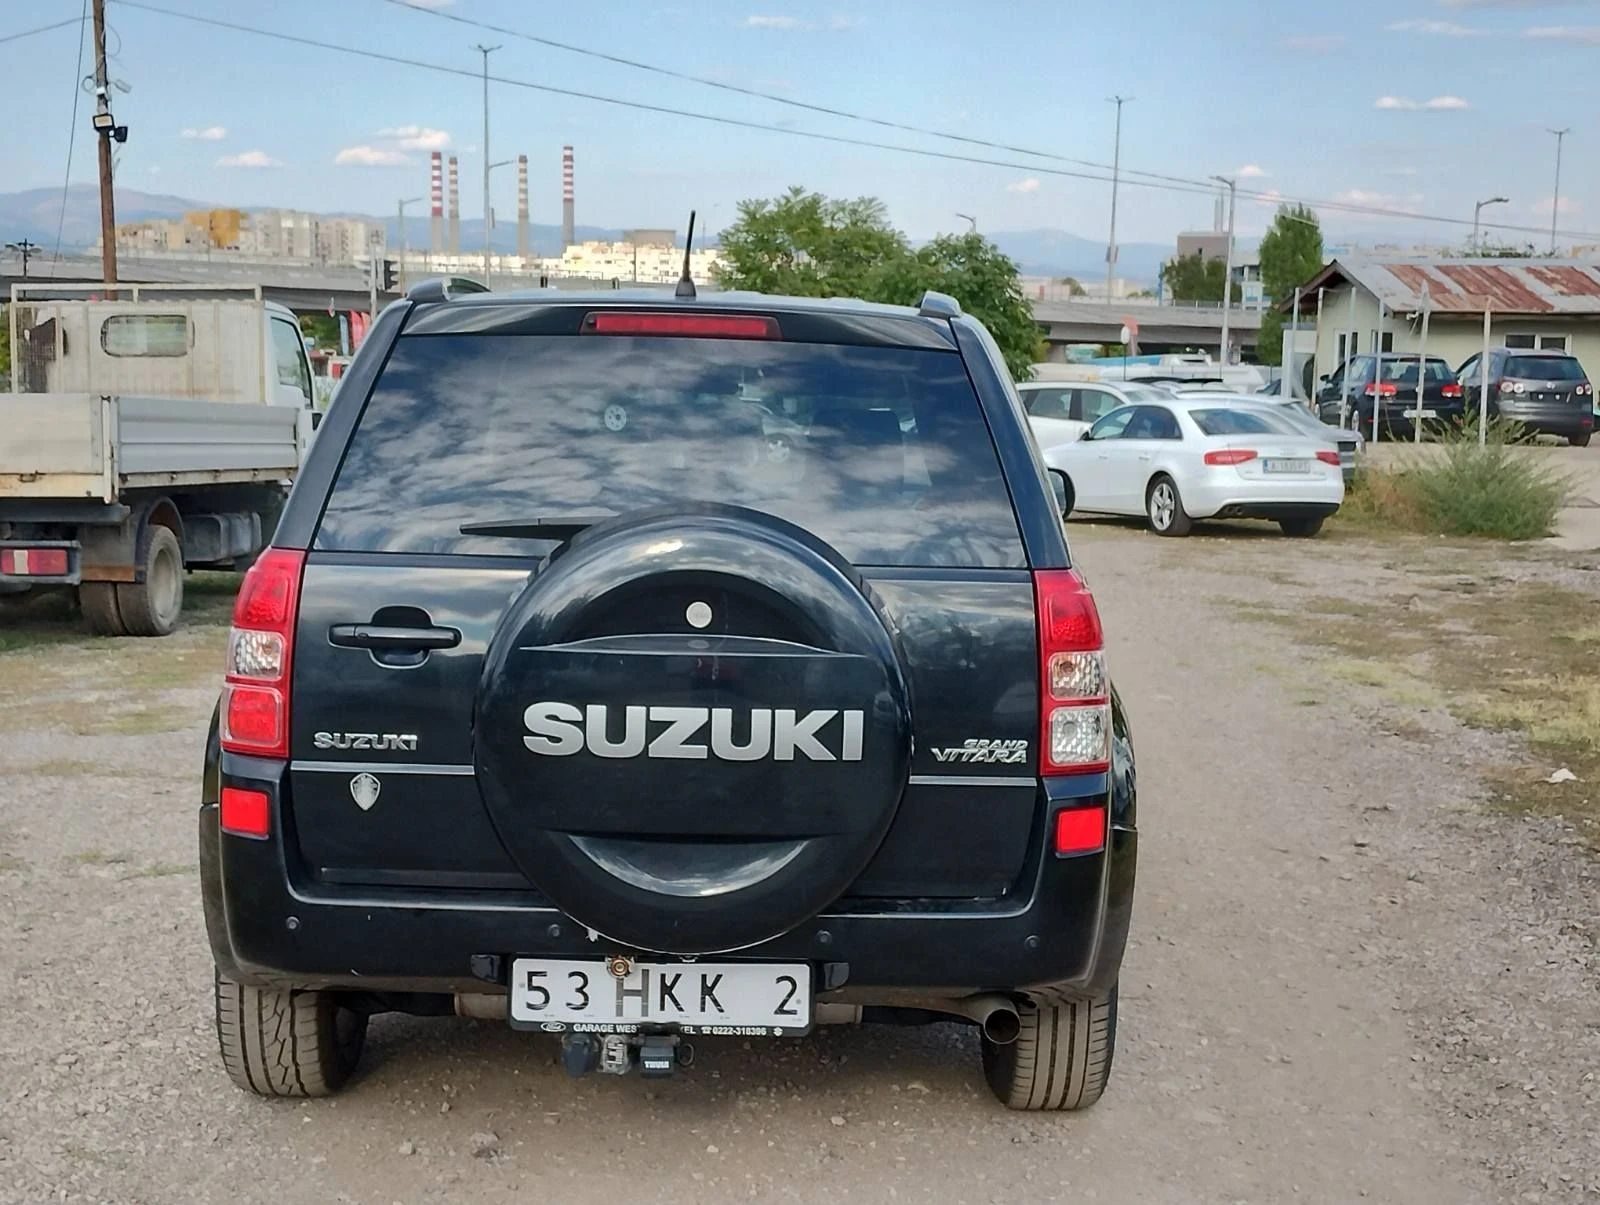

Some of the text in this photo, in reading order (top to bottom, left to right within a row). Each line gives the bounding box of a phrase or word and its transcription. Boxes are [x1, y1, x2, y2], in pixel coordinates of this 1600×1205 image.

[523, 701, 865, 761] SUZUKI
[313, 732, 418, 751] SUZUKI
[963, 739, 1028, 751] GRAND
[930, 748, 1028, 763] VITARA
[526, 970, 590, 1011] 53
[773, 975, 799, 1016] 2
[573, 1023, 614, 1034] GARAGE
[616, 1025, 641, 1034] WES
